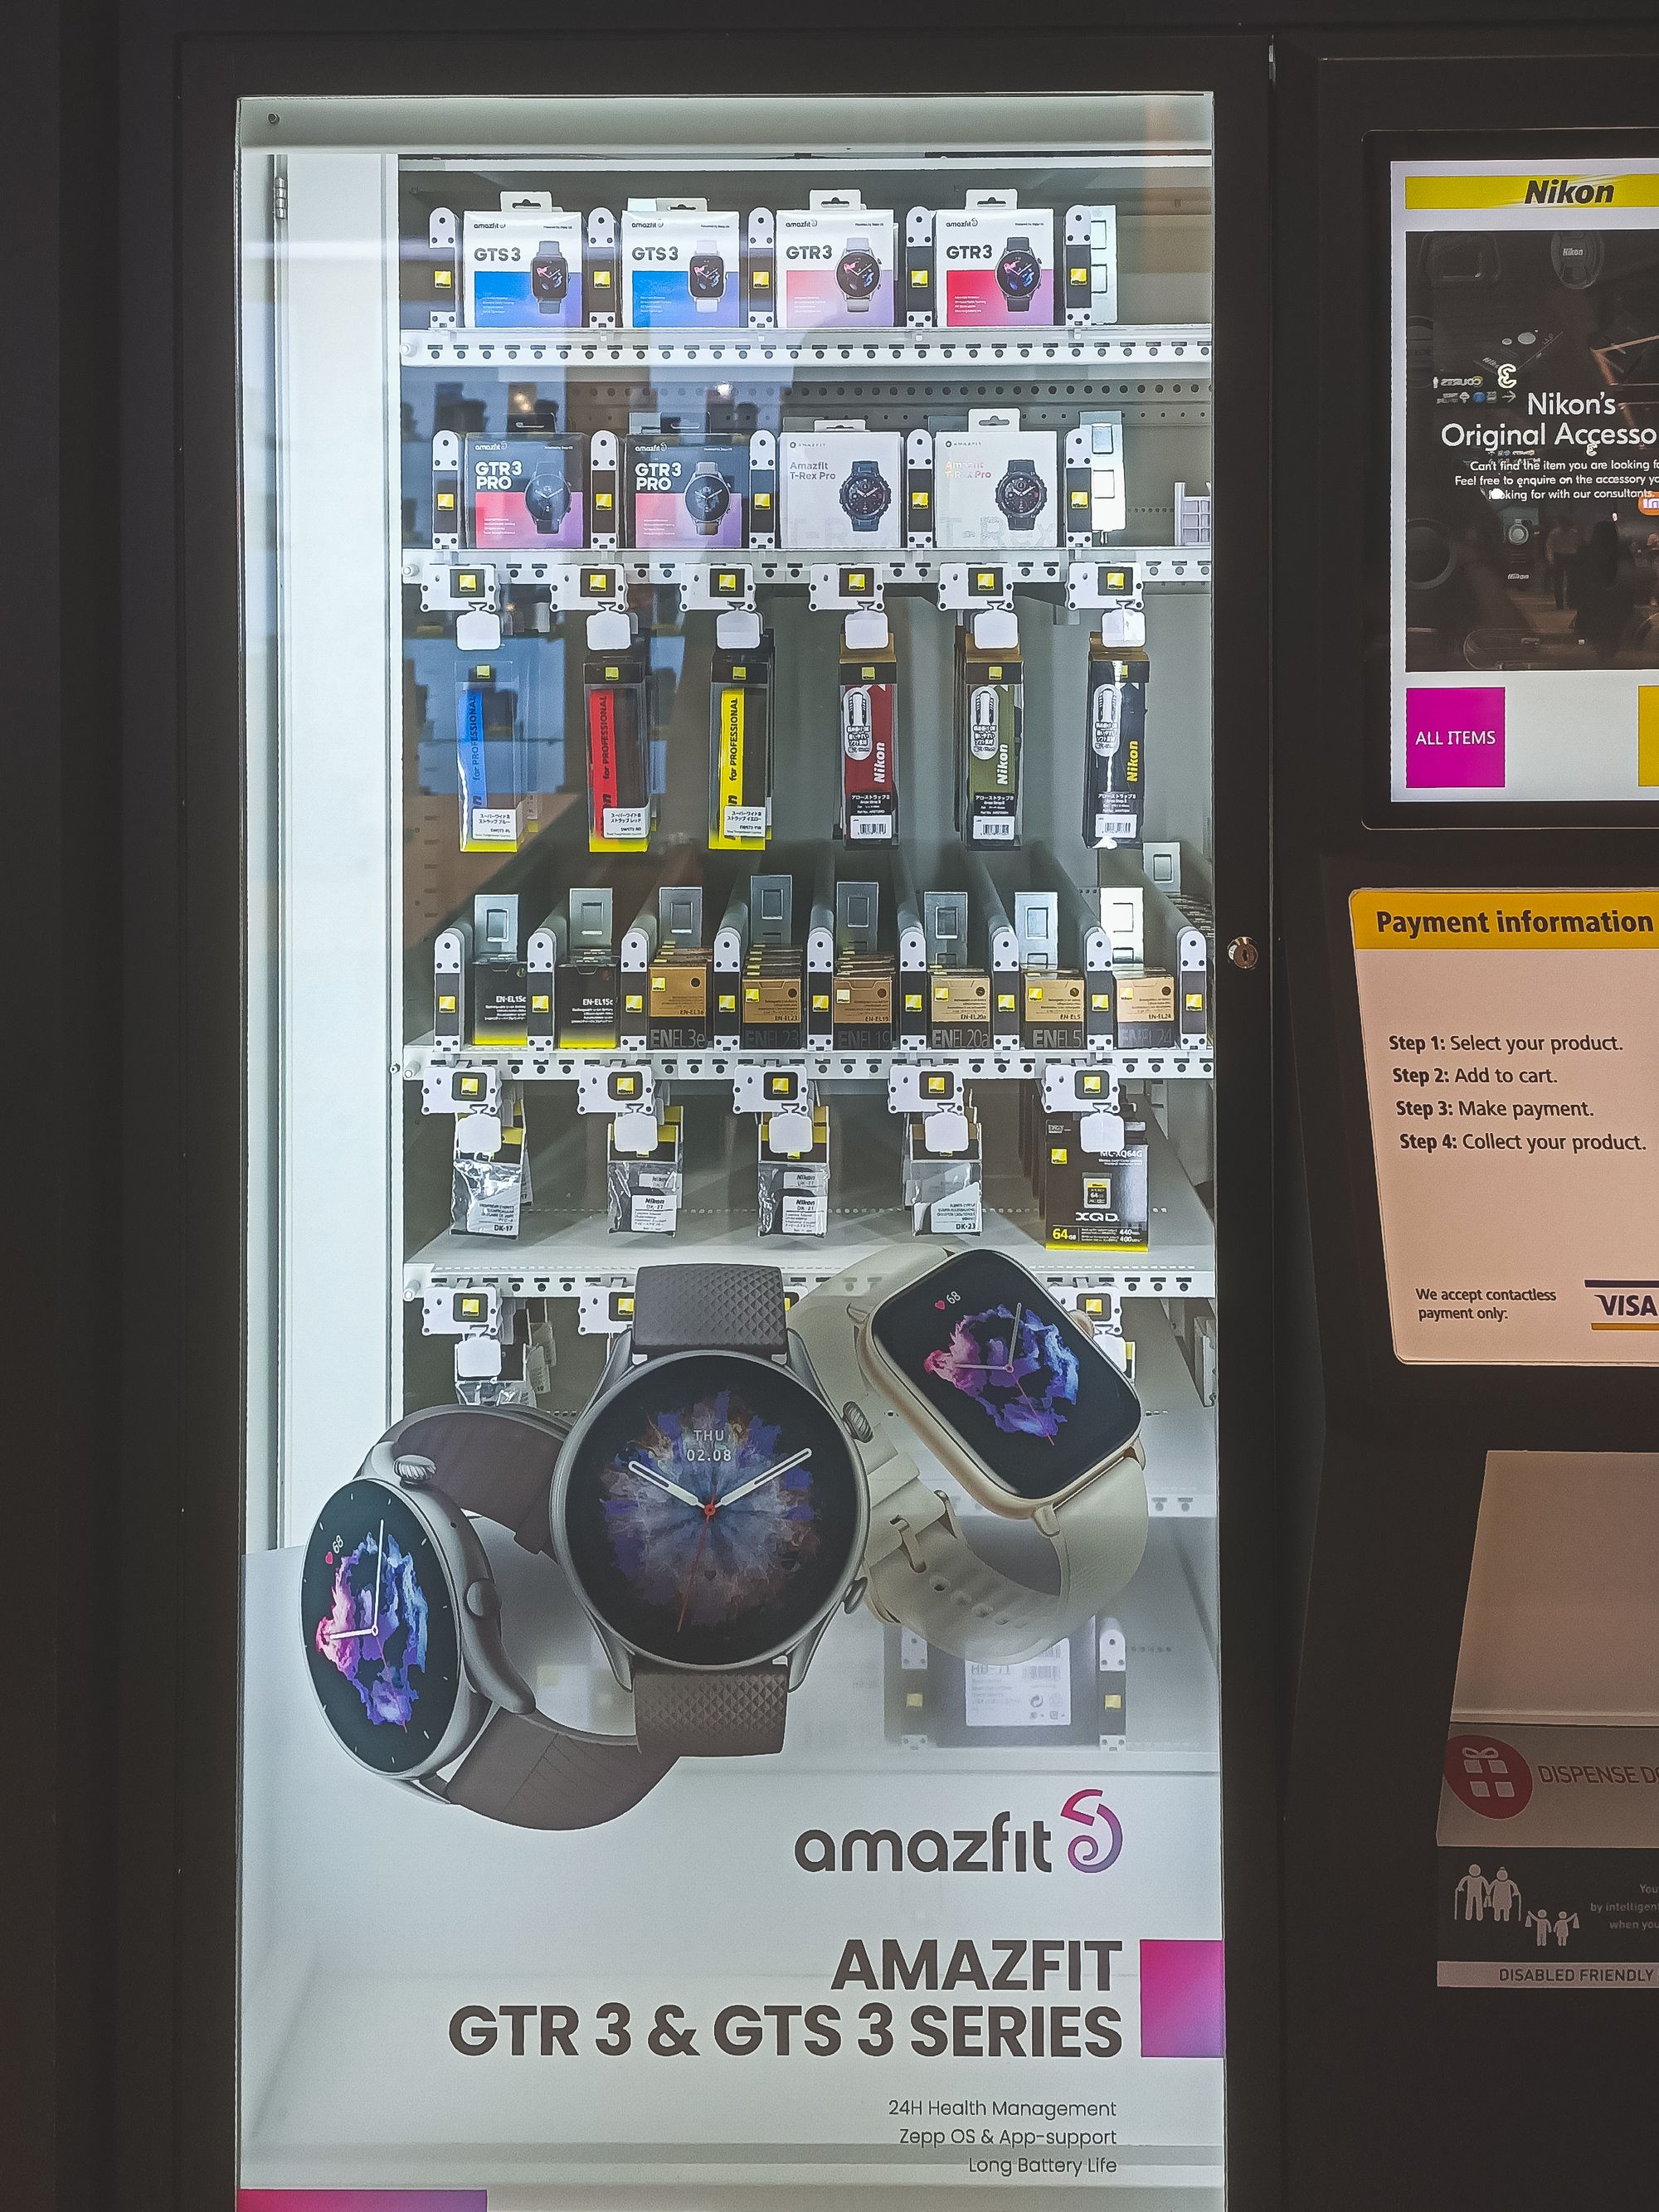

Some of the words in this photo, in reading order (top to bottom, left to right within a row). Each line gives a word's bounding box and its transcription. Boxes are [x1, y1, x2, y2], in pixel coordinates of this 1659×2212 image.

[1524, 180, 1615, 205] Nikon
[474, 248, 508, 262] GTS
[511, 247, 521, 261] 3
[631, 247, 666, 261] GTS
[669, 246, 679, 260] 3
[786, 246, 820, 260] GTR
[822, 245, 833, 260] 3
[946, 246, 981, 260] GTR
[983, 245, 993, 259] 3
[1528, 391, 1616, 415] Nikon's
[1442, 422, 1545, 451] Original
[474, 462, 511, 475] GTR
[512, 461, 523, 475] 3
[635, 463, 670, 477] GTR
[671, 462, 682, 477] 3
[790, 462, 829, 470] Amazfit
[1469, 460, 1496, 471] Can't
[1501, 460, 1520, 470] find
[1523, 459, 1540, 470] the
[1544, 459, 1566, 470] item
[1569, 462, 1588, 472] you
[1611, 459, 1651, 472] looking
[476, 476, 512, 489] PRO
[975, 470, 992, 479] Pro
[1455, 475, 1476, 485] Feel
[1480, 475, 1500, 485] free
[1503, 476, 1513, 484] to
[1517, 476, 1556, 487] enquire
[1576, 474, 1593, 484] the
[1596, 476, 1646, 485] accessory
[636, 478, 672, 491] PRO
[1488, 489, 1527, 500] lking
[1531, 489, 1545, 498] for
[1549, 489, 1570, 498] with
[1594, 489, 1656, 498] consultants.
[469, 696, 479, 765] PROFESSIONAL
[599, 696, 610, 764] PROFESSIONAL
[730, 698, 738, 766] PROFESSIONAL
[1415, 731, 1443, 746] ALL
[1447, 731, 1496, 746] ITEMS
[873, 742, 885, 783] Nikon
[997, 744, 1008, 785] Nikon
[1126, 741, 1138, 782] Nikon
[472, 767, 480, 780] for
[728, 768, 737, 781] for
[1376, 910, 1490, 939] Payment
[1496, 909, 1655, 933] information
[1389, 1035, 1426, 1054] Step
[1431, 1036, 1446, 1050] 1:
[1450, 1035, 1501, 1051] Select
[1506, 1038, 1545, 1054] your
[1551, 1035, 1623, 1054] product.
[1393, 1067, 1430, 1087] Step
[1433, 1068, 1450, 1083] 2:
[1454, 1067, 1490, 1083] Add
[1495, 1069, 1513, 1083] to
[1519, 1068, 1558, 1083] cart.
[1396, 1100, 1433, 1120] Step
[1438, 1101, 1453, 1116] 3:
[1458, 1100, 1507, 1116] Make
[1512, 1101, 1594, 1120] payment.
[1399, 1133, 1438, 1153] Step
[1442, 1134, 1457, 1150] 4:
[1462, 1133, 1522, 1150] Collect
[1526, 1136, 1566, 1154] your
[1572, 1134, 1647, 1154] product.
[946, 1291, 961, 1305] 68
[1415, 1288, 1438, 1300] We
[1441, 1289, 1483, 1304] accept
[1486, 1288, 1557, 1301] contactless
[1593, 1295, 1658, 1317] VISA
[1418, 1307, 1474, 1322] payment
[693, 1429, 725, 1441] THU
[686, 1449, 732, 1463] 02.08
[332, 1535, 343, 1555] 68
[1538, 1765, 1640, 1784] DISPENSE
[794, 1811, 1053, 1874] amazfit
[1590, 1903, 1603, 1913] by
[1609, 1919, 1639, 1929] when
[830, 1938, 1122, 1991] AMAZFIT
[1500, 1968, 1575, 1982] DISABLED
[1579, 1968, 1654, 1982] FRIENDLY
[448, 2003, 580, 2058] GTR
[595, 2002, 632, 2058] 3
[647, 2004, 701, 2058] &
[713, 2004, 843, 2058] GTS
[857, 2004, 895, 2059] 3
[910, 2005, 1123, 2059] SERIES
[888, 2100, 923, 2117] 24H
[928, 2099, 987, 2117] Health
[992, 2100, 1118, 2121] Management
[899, 2128, 946, 2149] Zepp
[951, 2128, 975, 2146] OS
[981, 2128, 995, 2146] &
[999, 2127, 1118, 2149] App-support
[969, 2157, 1013, 2179] Long
[1018, 2157, 1083, 2179] Battery
[1087, 2157, 1118, 2175] Life
